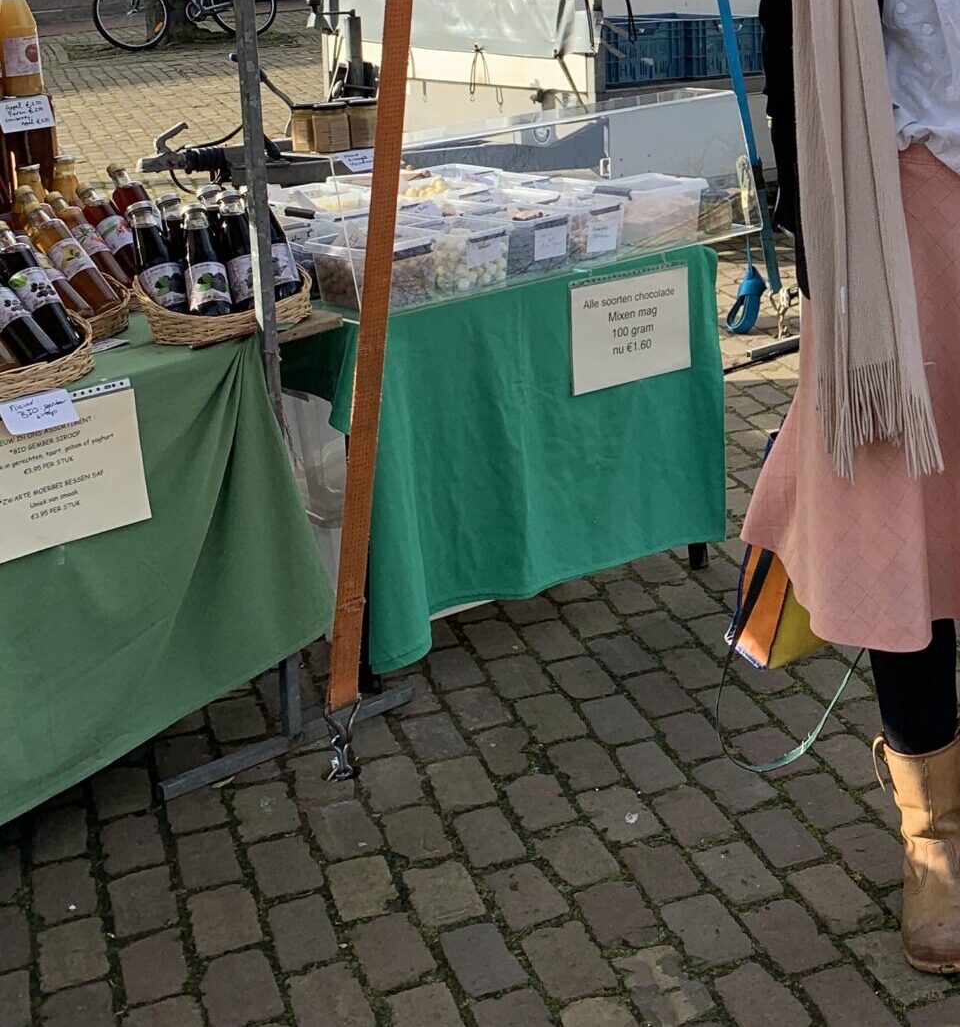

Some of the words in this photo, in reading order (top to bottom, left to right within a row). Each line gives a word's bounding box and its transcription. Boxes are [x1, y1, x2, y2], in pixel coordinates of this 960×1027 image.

[583, 299, 599, 309] Alle
[602, 294, 632, 307] soorten
[635, 287, 675, 301] chocolade
[608, 311, 636, 322] Mixen
[638, 306, 658, 317] mag
[612, 327, 628, 338] 100
[631, 323, 654, 337] gram
[612, 346, 624, 355] nu
[626, 339, 652, 353] €1.60
[28, 437, 54, 451] GEMBER
[56, 430, 80, 443] SIROOP
[91, 433, 114, 445] yoghurt
[42, 461, 55, 469] PER
[56, 455, 76, 465] STUK
[33, 482, 63, 495] MOERBEI
[64, 474, 90, 487] BESSEN
[92, 469, 104, 479] SAP
[50, 505, 62, 515] PER
[63, 499, 81, 511] STUK
